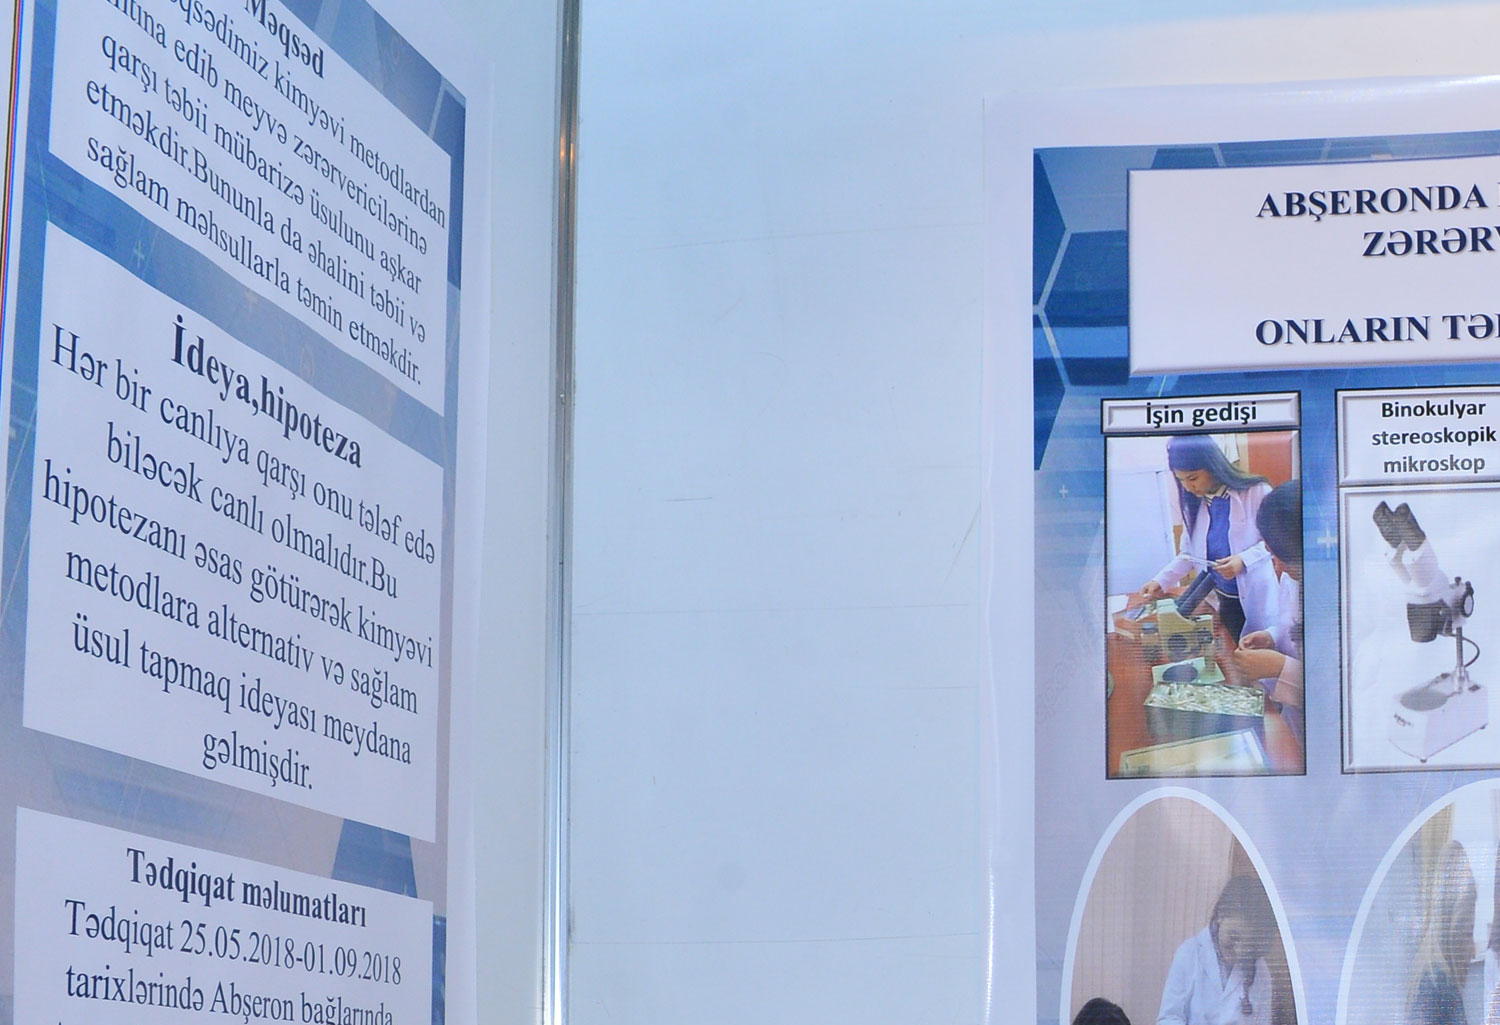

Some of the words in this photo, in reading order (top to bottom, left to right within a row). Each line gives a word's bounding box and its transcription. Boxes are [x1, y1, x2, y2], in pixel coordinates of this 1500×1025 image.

[102, 36, 158, 94] qarşı
[164, 78, 207, 135] təbii
[214, 123, 304, 205] mübarizə
[310, 189, 374, 261] üsulunu
[380, 251, 421, 294] aşkar
[174, 40, 218, 88] edib
[224, 79, 287, 144] meyvə
[293, 135, 427, 255] zərərvericilərinə
[274, 61, 344, 145] kimyəvi
[350, 135, 445, 228] metodlardan
[1256, 184, 1489, 223] ABŞERONDA
[88, 137, 169, 211] sağlam
[176, 198, 290, 294] məhsullarla
[296, 278, 342, 332] təmin
[349, 321, 420, 385] etməkdir.
[281, 217, 303, 253] da
[308, 240, 364, 299] əhalini
[370, 284, 404, 328] təbii
[410, 316, 425, 342] və
[1256, 316, 1431, 346] ONLARIN
[51, 323, 108, 388] Hər
[116, 359, 152, 413] bir
[160, 398, 249, 465] canlıya
[257, 450, 306, 500] qarşı
[313, 482, 353, 520] onu
[359, 500, 402, 546] tələf
[405, 529, 435, 564] edə
[1146, 402, 1184, 427] İşin
[1193, 401, 1257, 426] gedişi
[1372, 426, 1497, 446] stereoskopik
[1381, 401, 1486, 419] Binokulyar
[107, 422, 203, 504] biləcək
[211, 487, 263, 535] canlı
[1384, 454, 1485, 473] mikroskop
[42, 459, 186, 560] hipotezanı
[195, 542, 242, 584] əsas
[250, 565, 352, 633] götürərək
[357, 605, 432, 668] kimyəvi
[65, 552, 200, 629] metodlara
[208, 604, 314, 672] alternativ
[321, 656, 344, 685] və
[351, 668, 417, 714] sağlam
[72, 613, 130, 668] üsul
[140, 641, 231, 714] tapmaq
[240, 672, 316, 733] ideyası
[323, 715, 411, 764] meydana
[203, 731, 312, 789] gəlmişdir.
[127, 848, 235, 907] Tədqiqat
[242, 880, 366, 927] məlumatları
[65, 899, 174, 957] Tədqiqat
[180, 920, 401, 985] 25.05.2018-01.09.2018
[66, 965, 204, 1011] tarixlərində
[209, 981, 294, 1024] Abşeron
